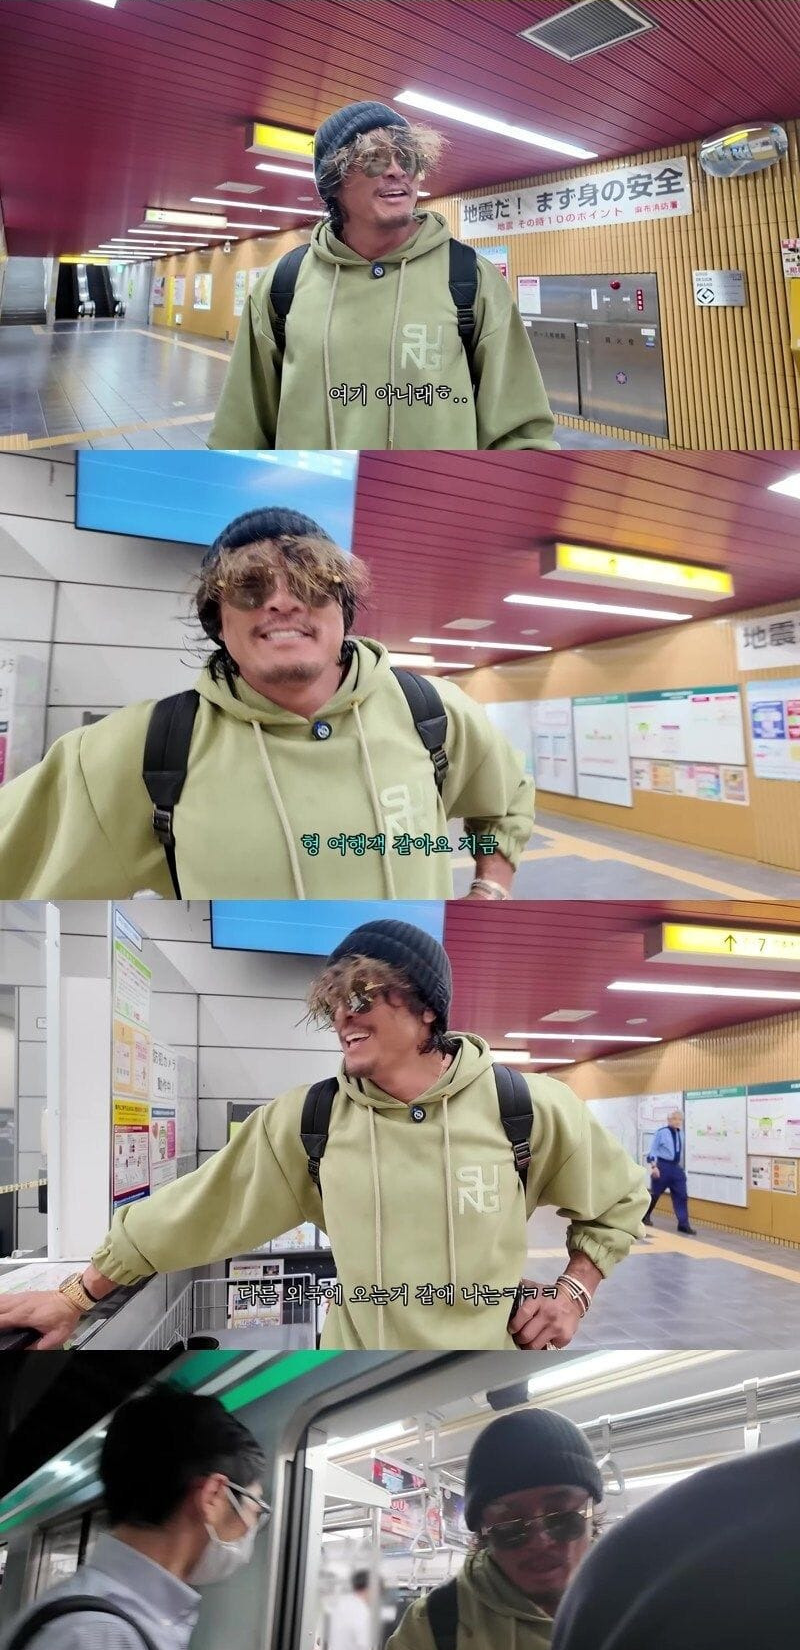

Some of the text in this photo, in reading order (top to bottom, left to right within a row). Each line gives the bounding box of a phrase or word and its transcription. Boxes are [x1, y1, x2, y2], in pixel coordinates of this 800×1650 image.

[536, 167, 685, 212] まず身の安全
[497, 220, 513, 232] 地震
